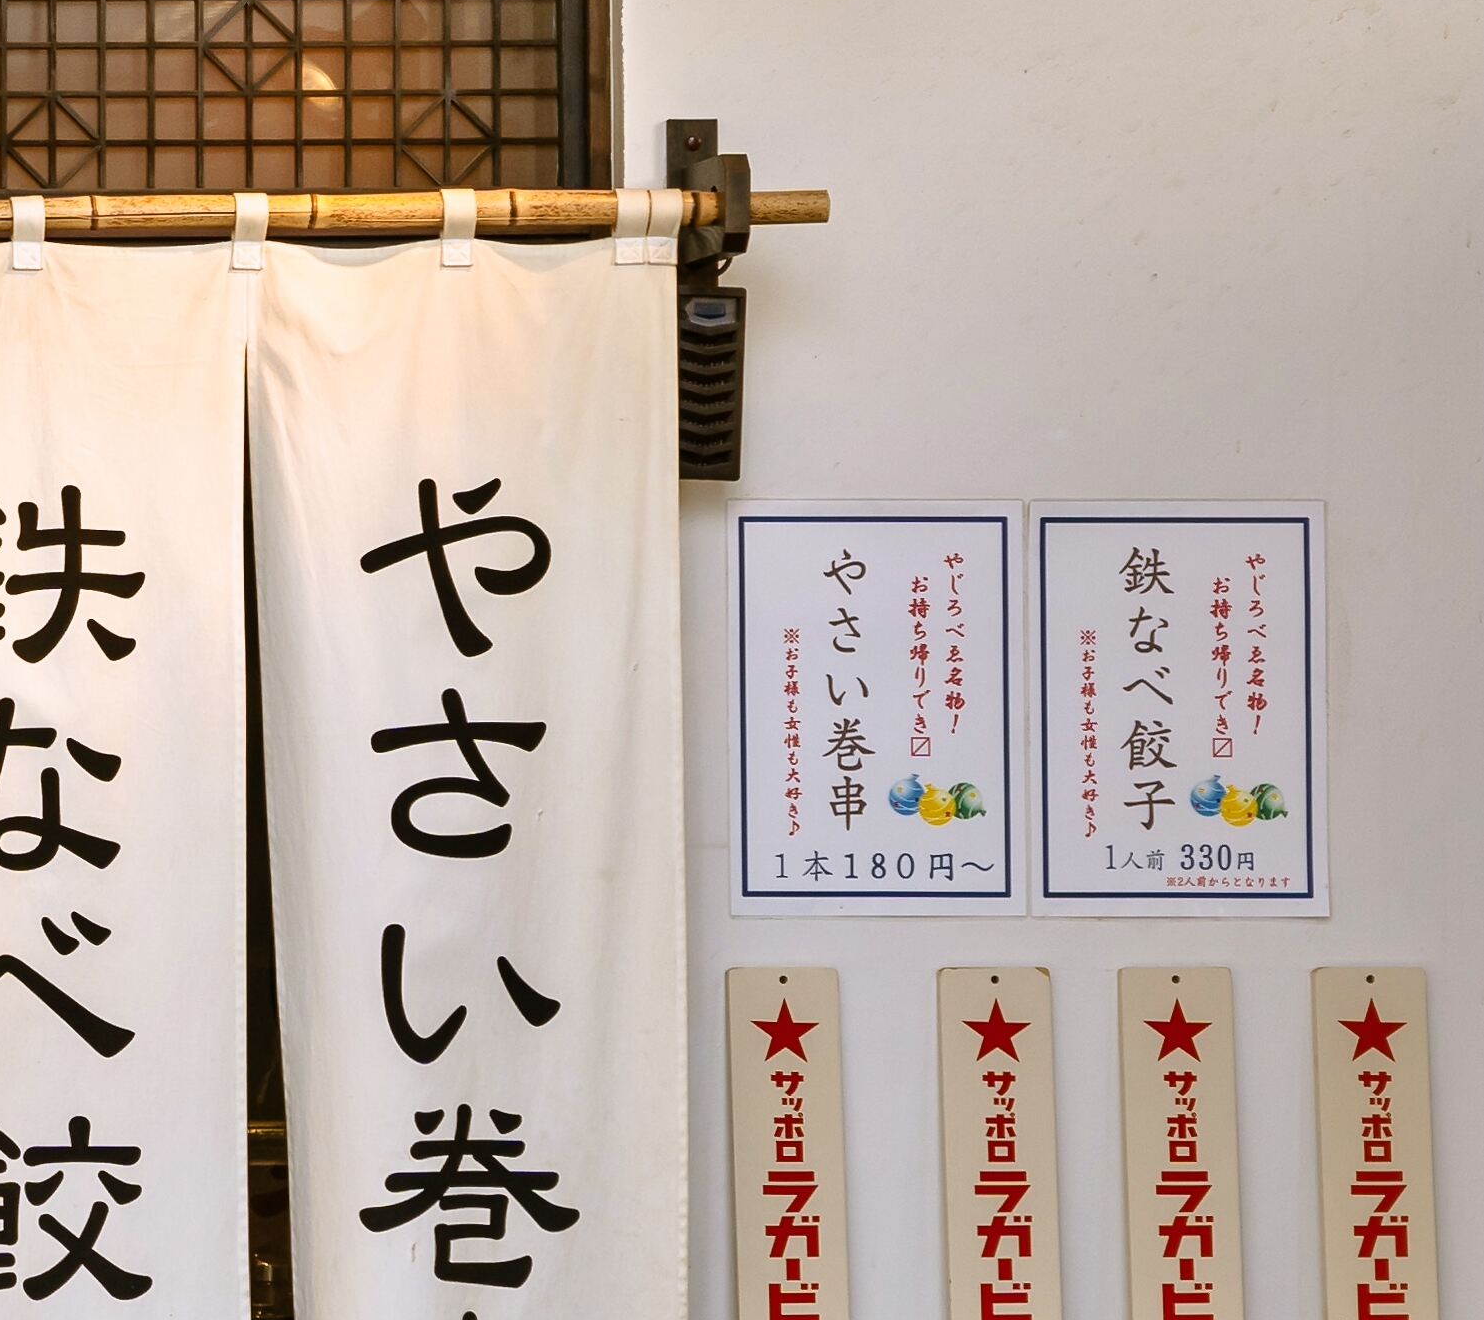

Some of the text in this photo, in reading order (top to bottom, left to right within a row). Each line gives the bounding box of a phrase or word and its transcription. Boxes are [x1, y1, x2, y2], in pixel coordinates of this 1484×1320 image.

[822, 548, 877, 832] やさい巻串
[1118, 546, 1178, 832] 鉄なべ餃子
[1104, 843, 1255, 872] 1人前 330円
